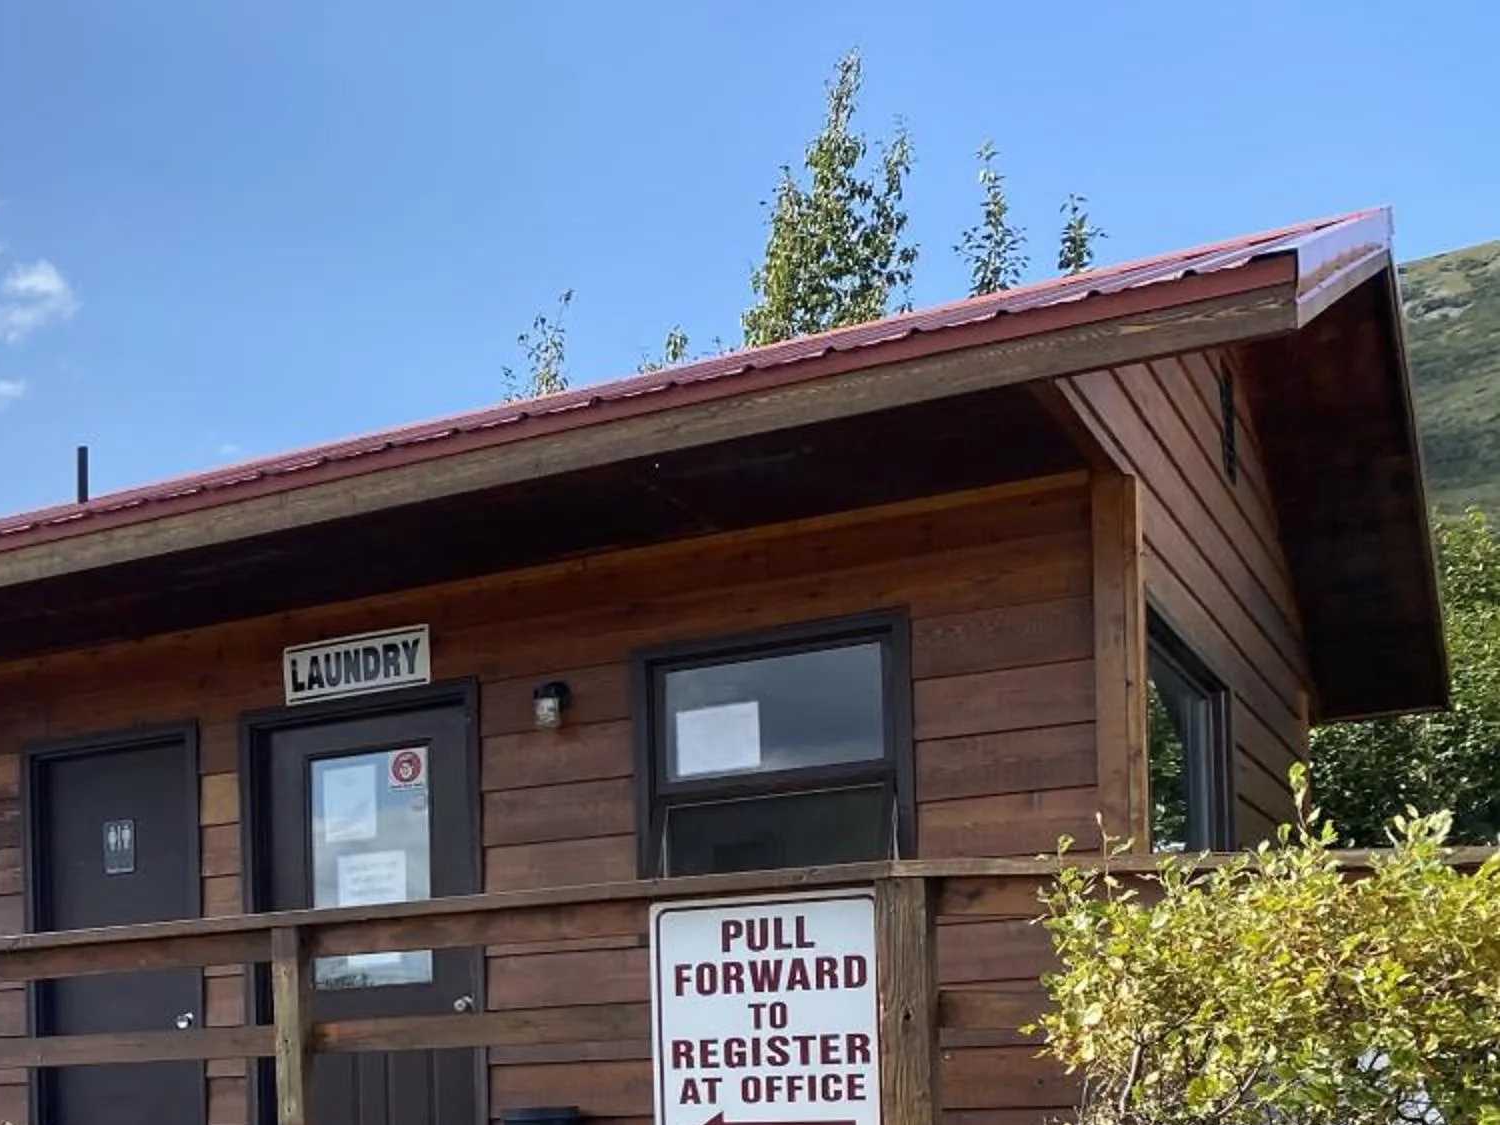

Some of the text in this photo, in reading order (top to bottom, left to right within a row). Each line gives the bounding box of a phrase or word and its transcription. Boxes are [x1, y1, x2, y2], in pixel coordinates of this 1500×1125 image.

[291, 638, 420, 692] LAUNDRY
[721, 915, 815, 953] PULL
[674, 955, 868, 996] FORWARD
[747, 1001, 788, 1029] TO
[671, 1033, 871, 1069] REGISTER
[679, 1074, 867, 1105] AT OFFICE
